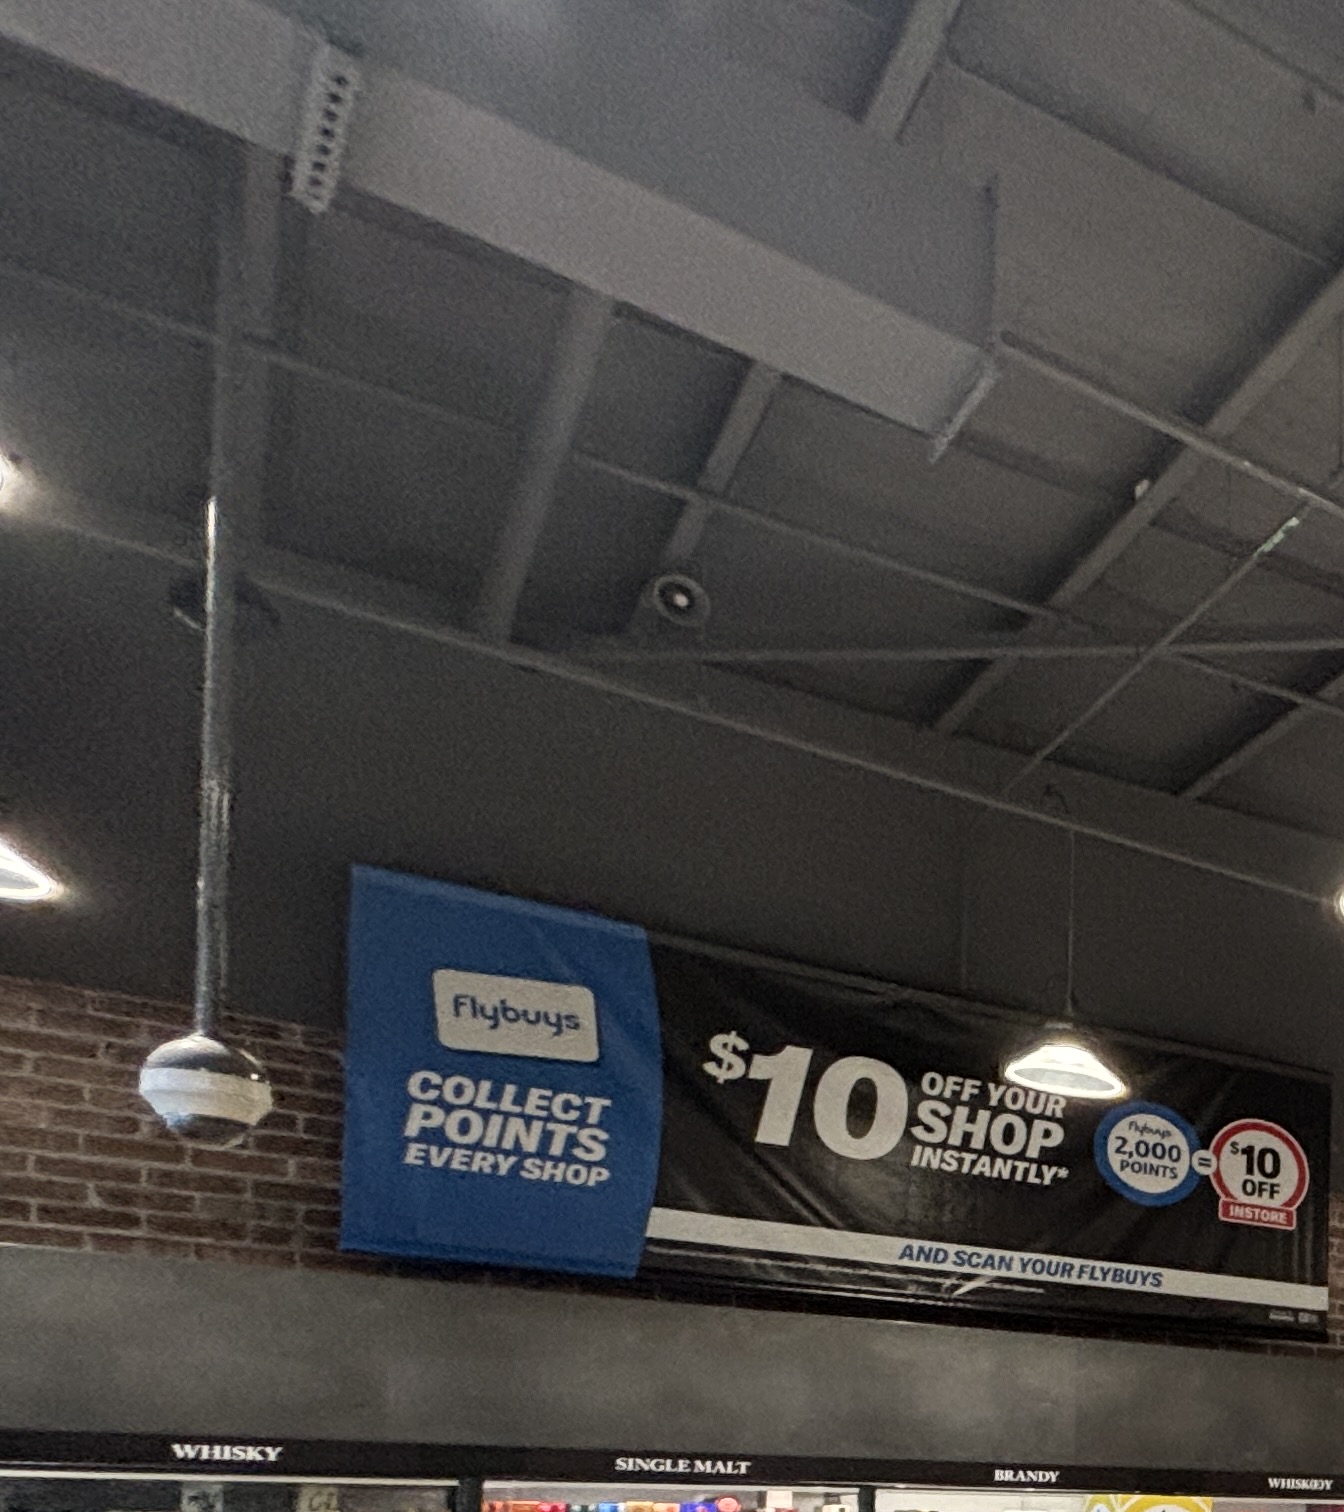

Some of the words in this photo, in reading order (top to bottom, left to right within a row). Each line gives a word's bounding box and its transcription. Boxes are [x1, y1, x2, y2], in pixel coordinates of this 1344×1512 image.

[453, 994, 581, 1036] Flybuys
[407, 1071, 612, 1125] COLLECT
[702, 1031, 909, 1160] $10
[921, 1071, 984, 1102] OFF
[987, 1082, 1068, 1119] YOUR
[404, 1102, 610, 1162] POINTS
[911, 1100, 1065, 1159] SHOP
[1128, 1120, 1171, 1138] Flybuys
[403, 1143, 518, 1176] EVERY
[520, 1158, 611, 1187] SHOP
[1114, 1136, 1181, 1164] 2,000
[1120, 1158, 1178, 1179] POINTS
[1230, 1141, 1281, 1179] $10
[1242, 1178, 1281, 1200] OFF
[1229, 1205, 1287, 1224] INSTORE
[898, 1244, 949, 1265] AND
[952, 1253, 1014, 1273] SCAN
[1019, 1257, 1076, 1277] YOUR
[1077, 1263, 1164, 1288] FLYBUYS
[171, 1443, 283, 1462] WHISKY
[615, 1457, 691, 1473] SINGLE
[693, 1460, 752, 1475] MALT
[994, 1469, 1060, 1483] BRANDY
